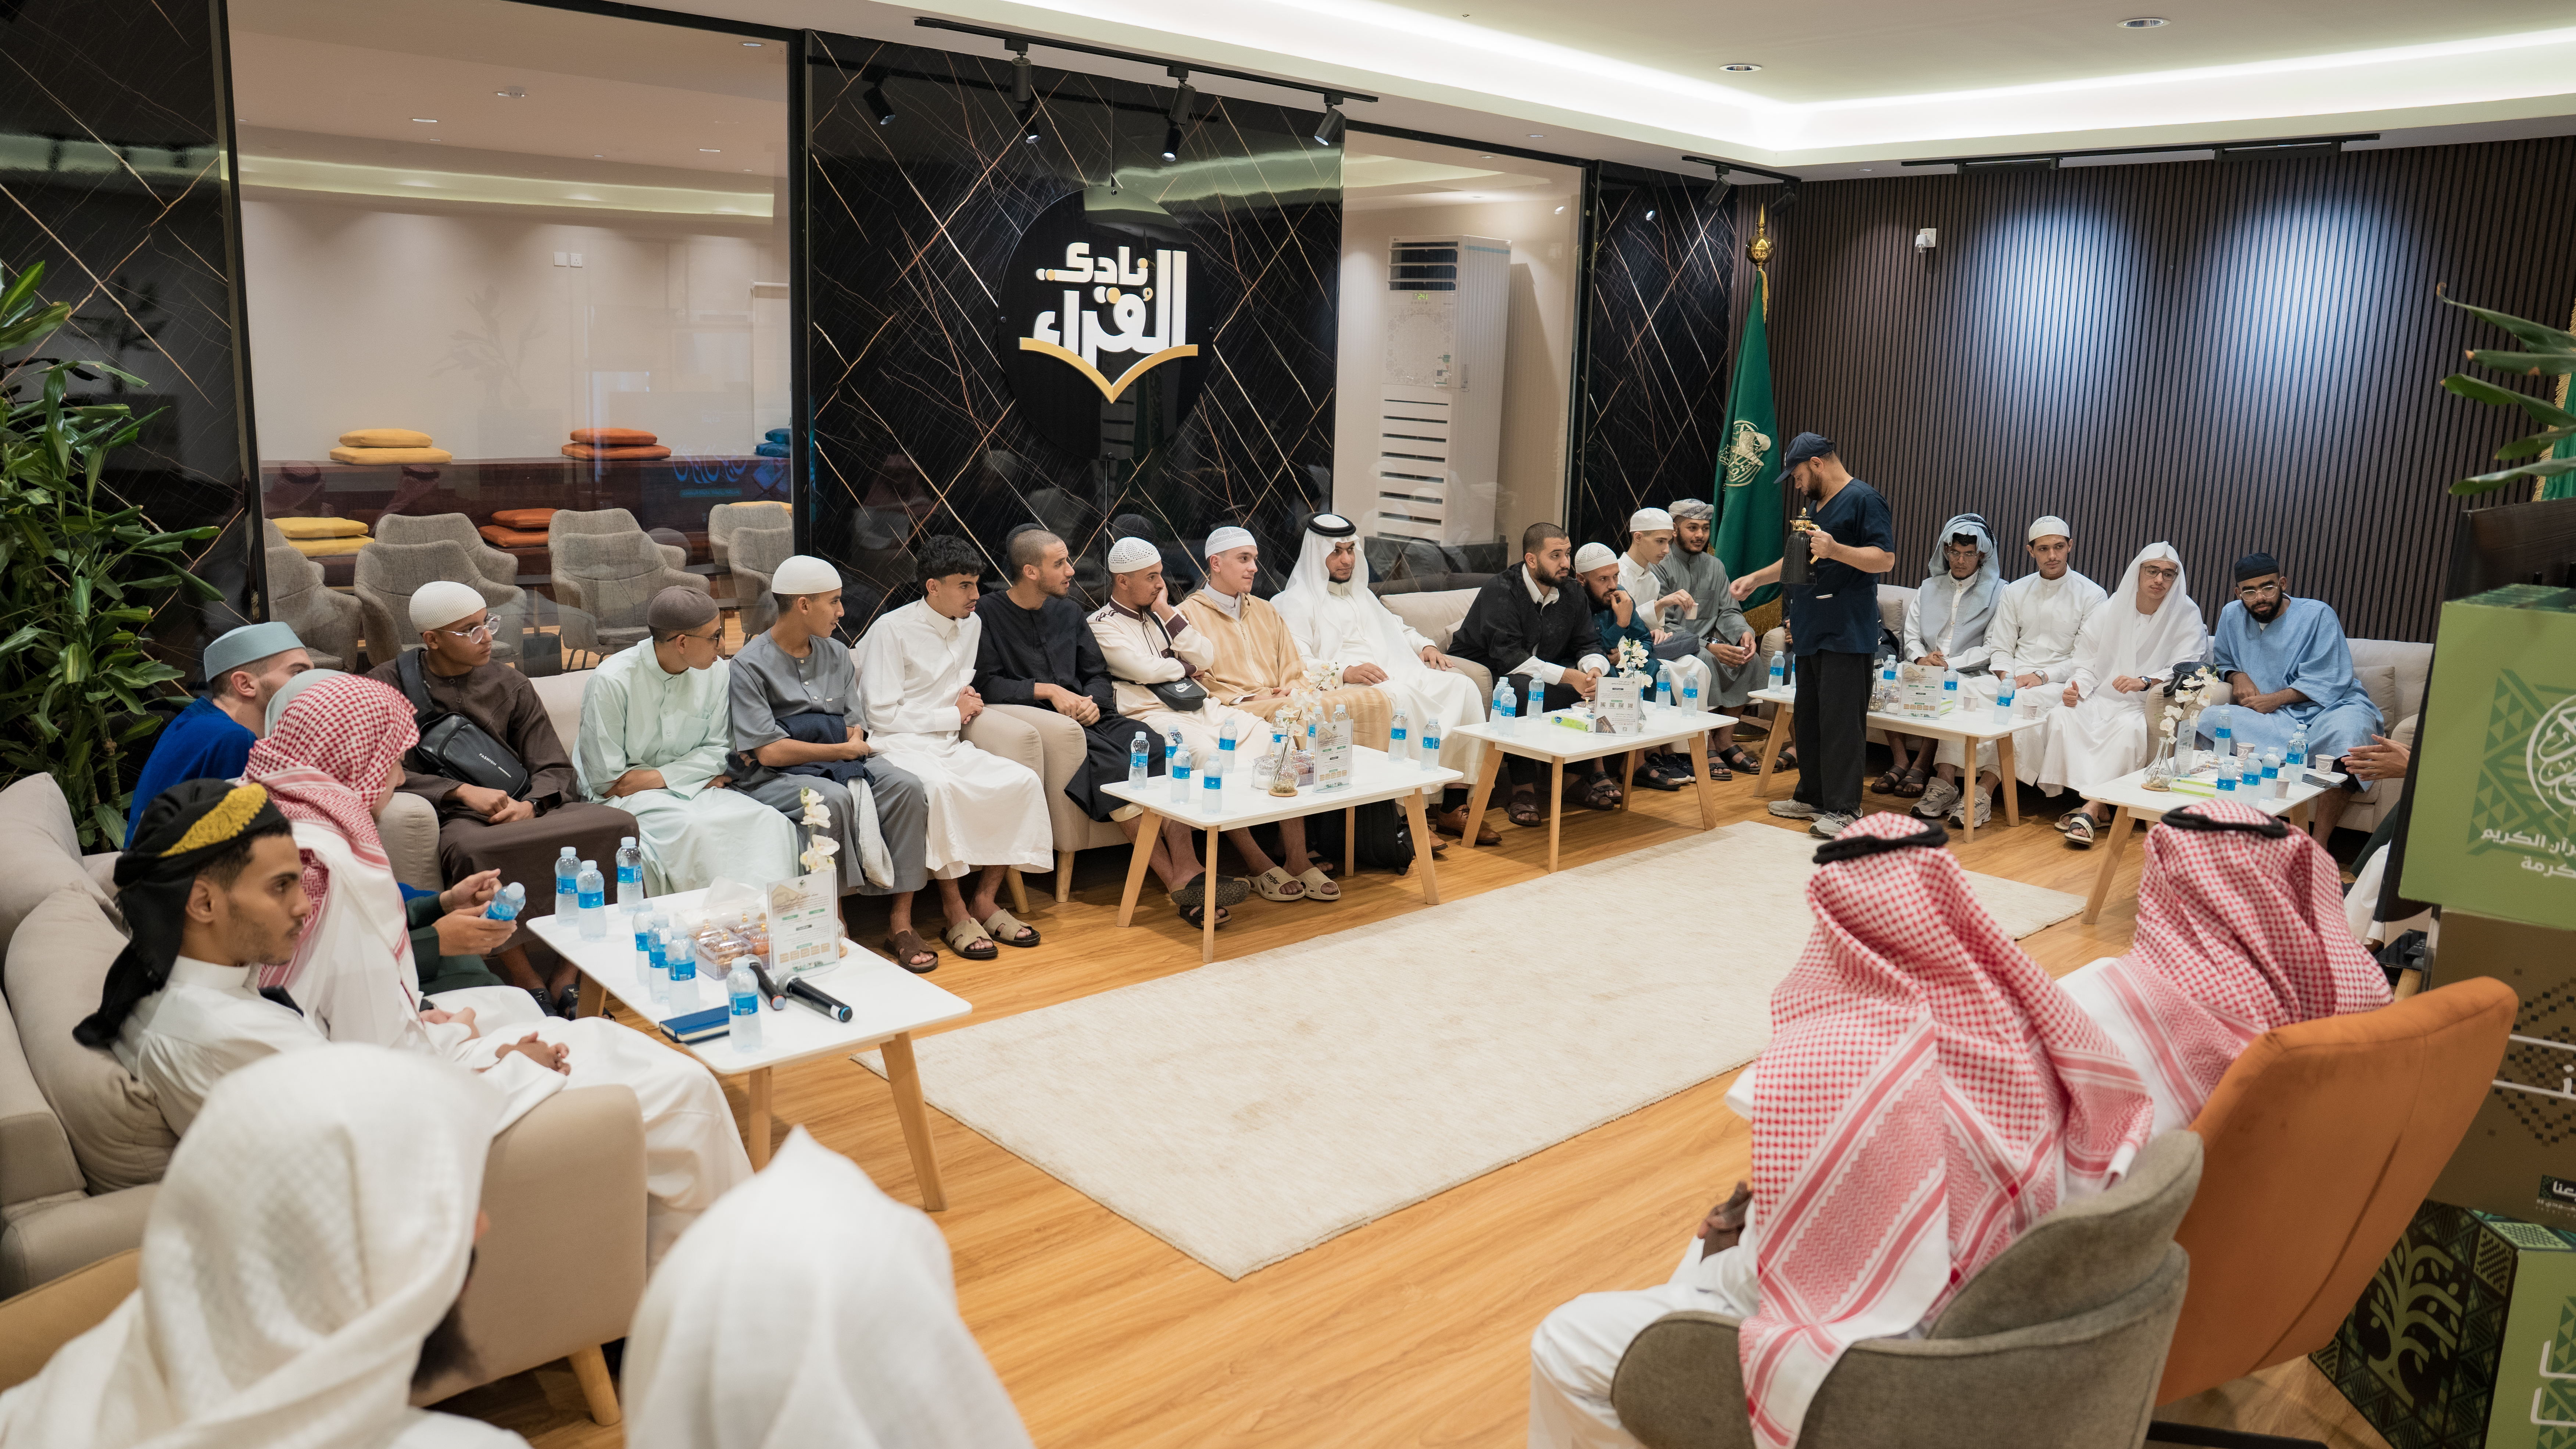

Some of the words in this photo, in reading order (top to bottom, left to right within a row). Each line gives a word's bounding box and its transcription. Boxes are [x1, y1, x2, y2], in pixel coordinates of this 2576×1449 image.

[1036, 243, 1148, 286] نادي
[479, 753, 497, 766] FASHION
[2480, 828, 2547, 848] الكريم
[2548, 837, 2576, 857] رآن
[2520, 855, 2576, 879] كرمة
[2553, 1181, 2576, 1198] عنا
